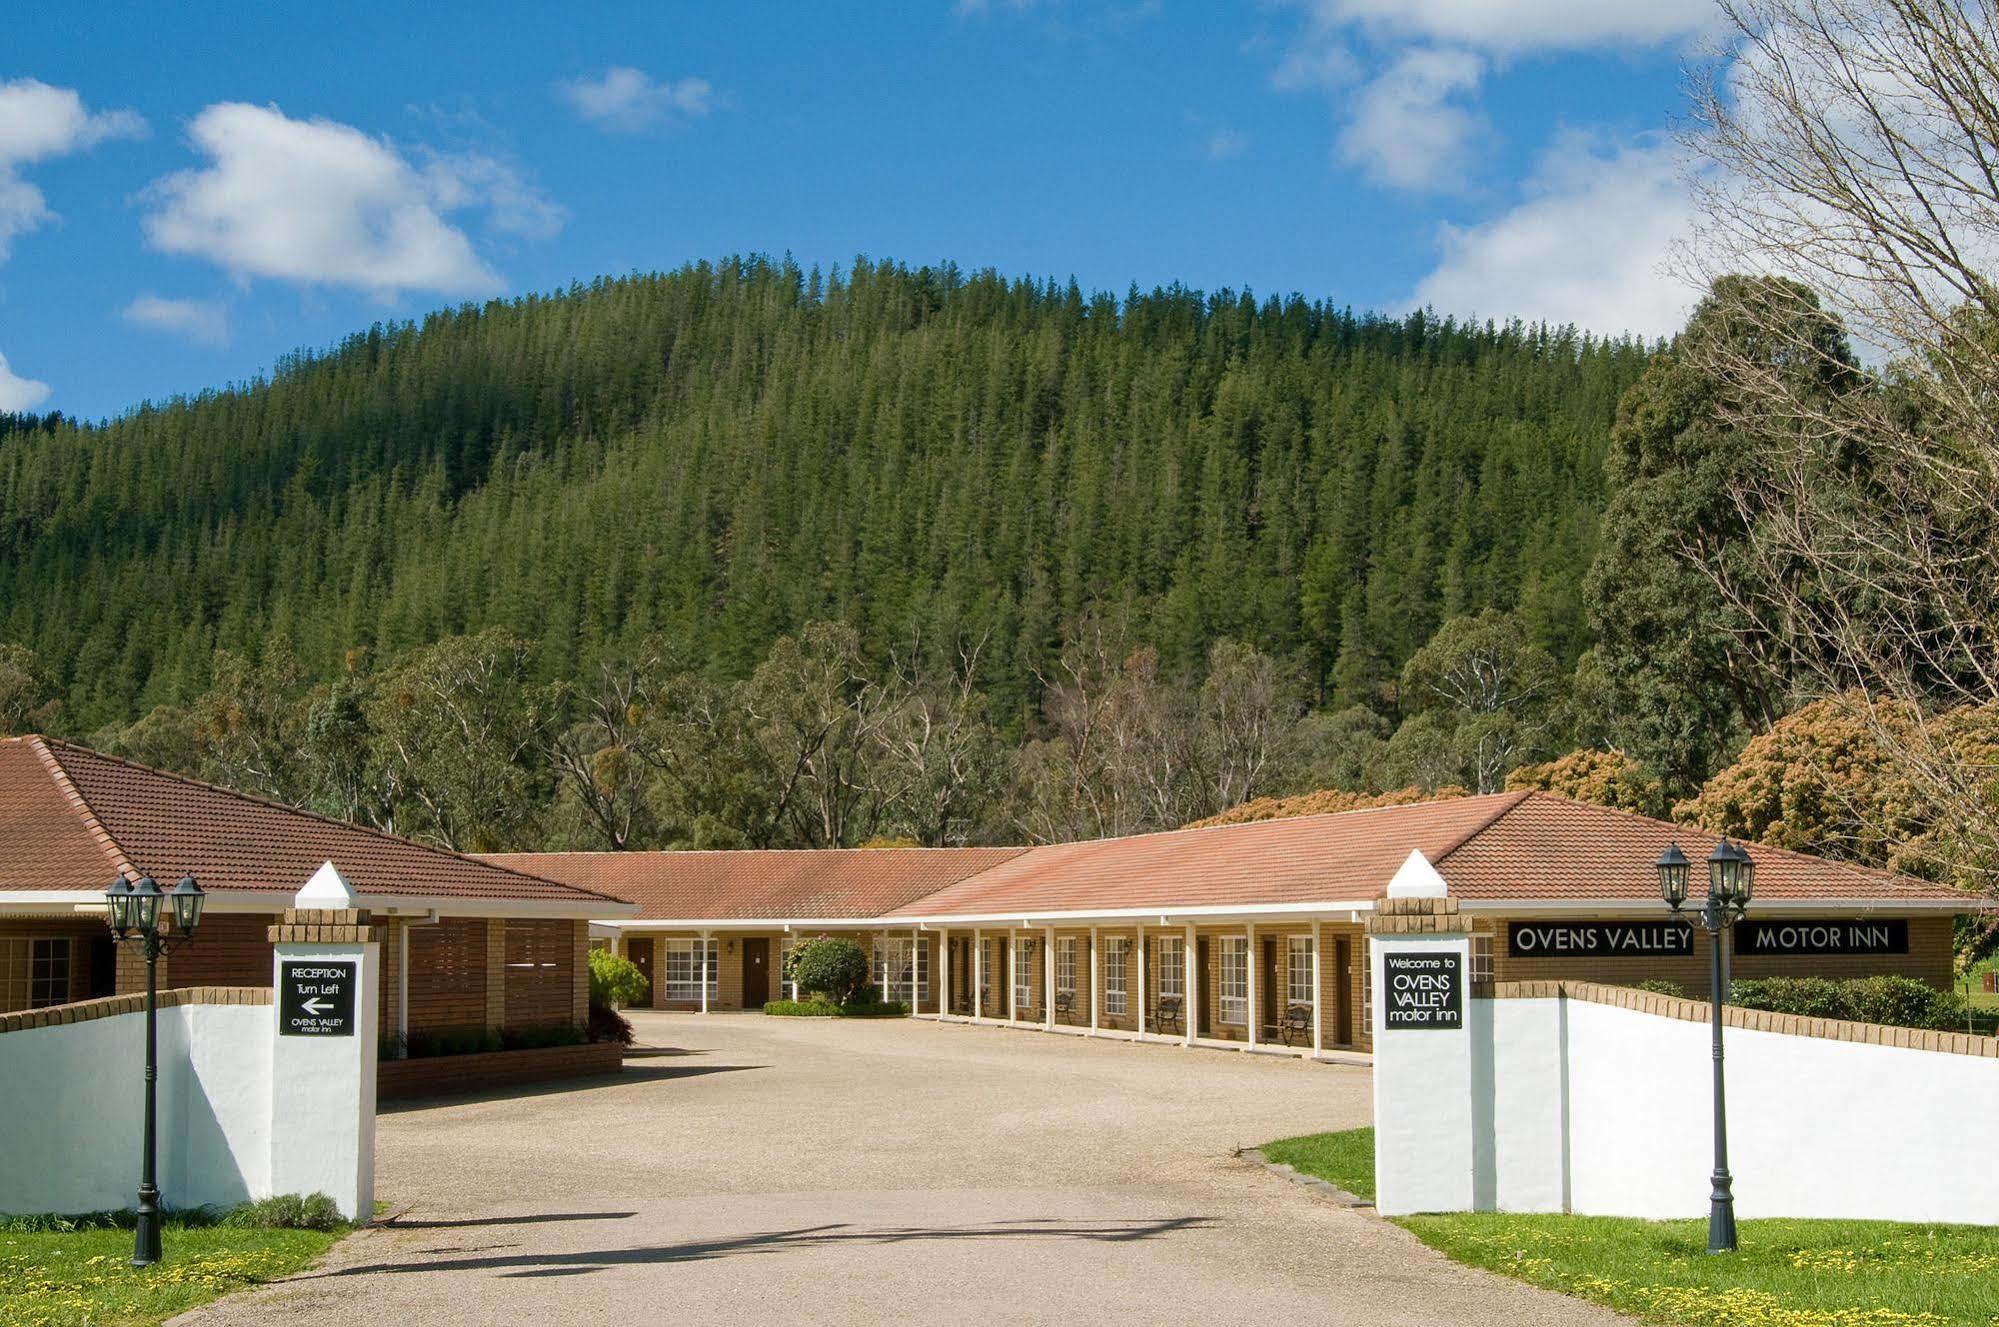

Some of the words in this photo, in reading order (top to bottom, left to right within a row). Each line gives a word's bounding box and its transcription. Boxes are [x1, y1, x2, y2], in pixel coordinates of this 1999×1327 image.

[1516, 928, 1598, 950] OVENS
[1605, 928, 1691, 949] VALLEY
[1756, 927, 1841, 948] MOTOR
[1849, 927, 1889, 947] INN
[1389, 958, 1440, 969] Welcome
[1444, 958, 1455, 969] to
[291, 968, 346, 978] RECEPTION
[297, 983, 318, 994] Turn
[321, 983, 339, 994] Left
[1393, 974, 1450, 990] OVENS
[1393, 992, 1451, 1007] VALLEY
[291, 1018, 317, 1026] OVENS
[318, 1018, 344, 1026] VALLEY
[1389, 1008, 1432, 1022] motor
[1436, 1007, 1457, 1021] inn
